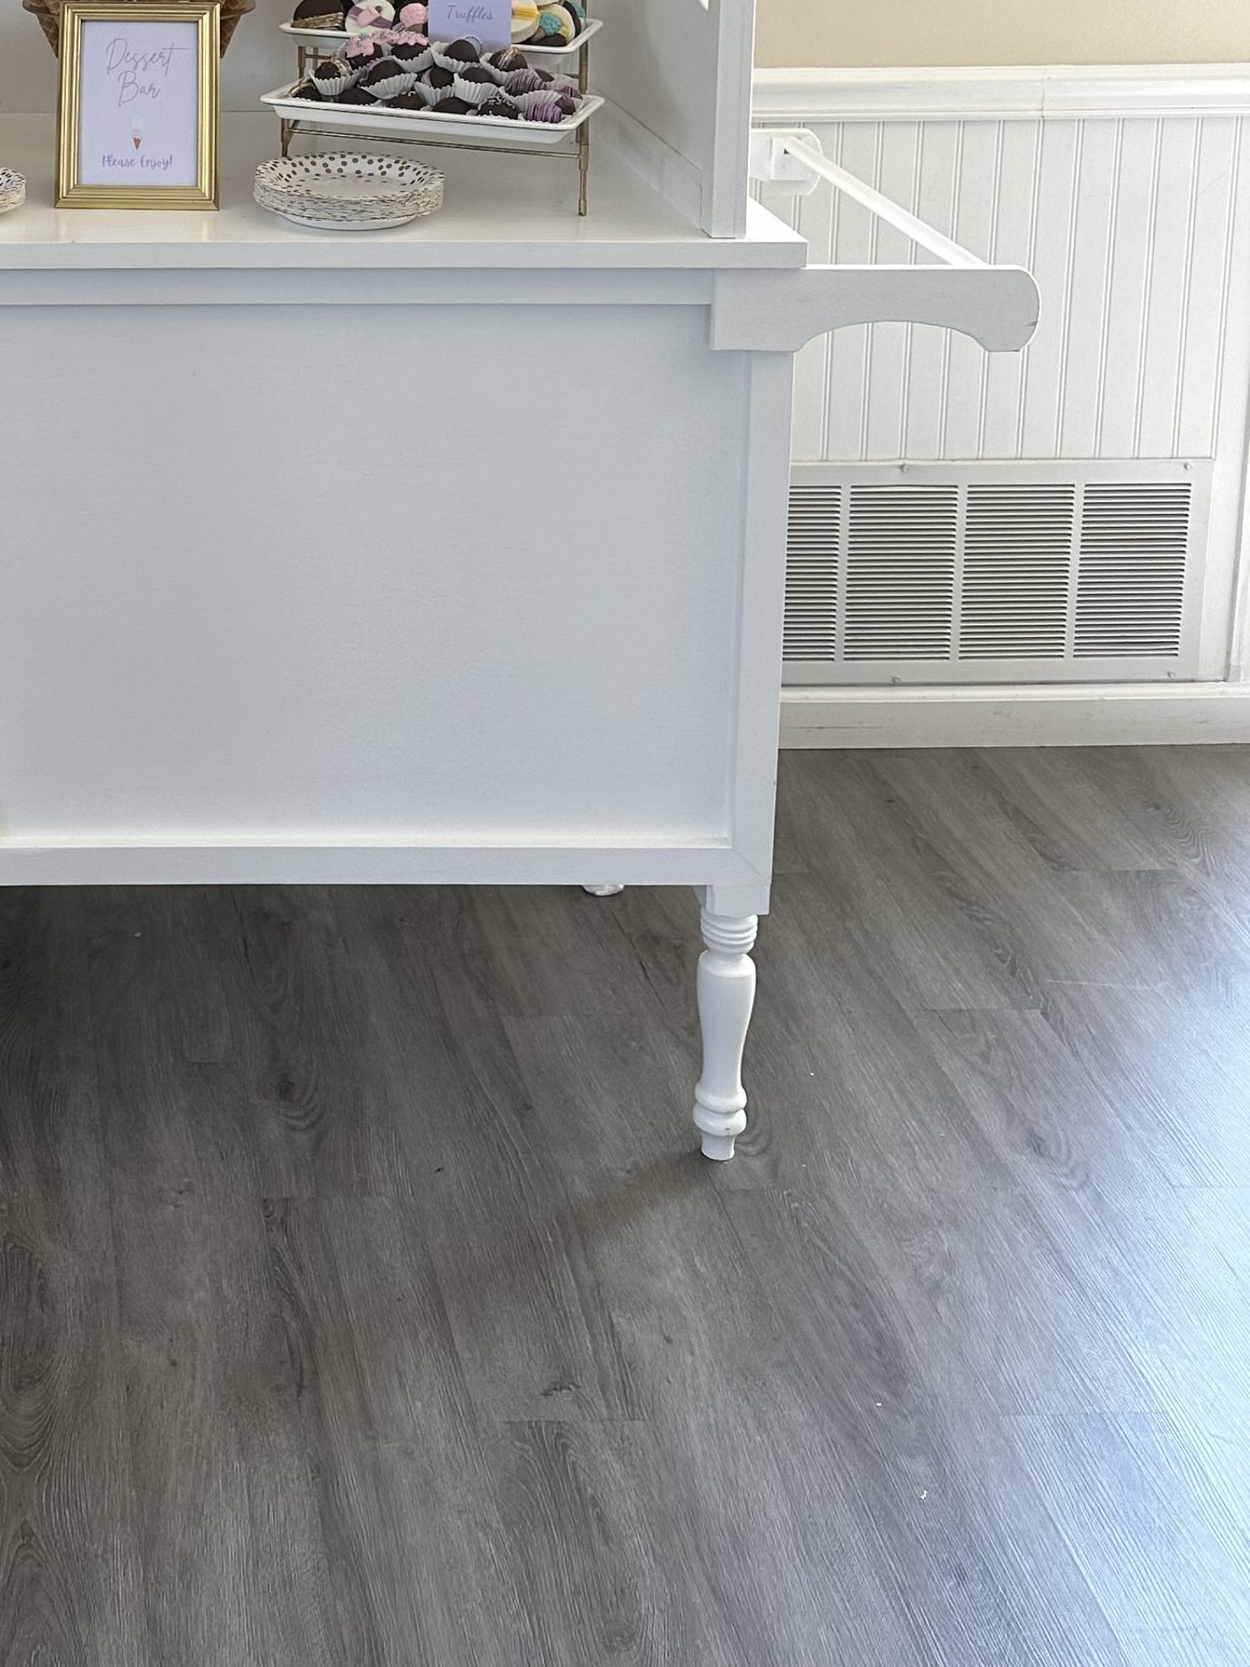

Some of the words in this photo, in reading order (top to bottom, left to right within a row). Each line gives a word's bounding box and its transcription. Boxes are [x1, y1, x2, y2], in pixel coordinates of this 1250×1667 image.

[447, 5, 493, 22] Truffles
[106, 38, 190, 77] Dessert
[118, 70, 160, 107] Bar
[102, 155, 135, 168] Please
[140, 155, 173, 170] Enjoy!
